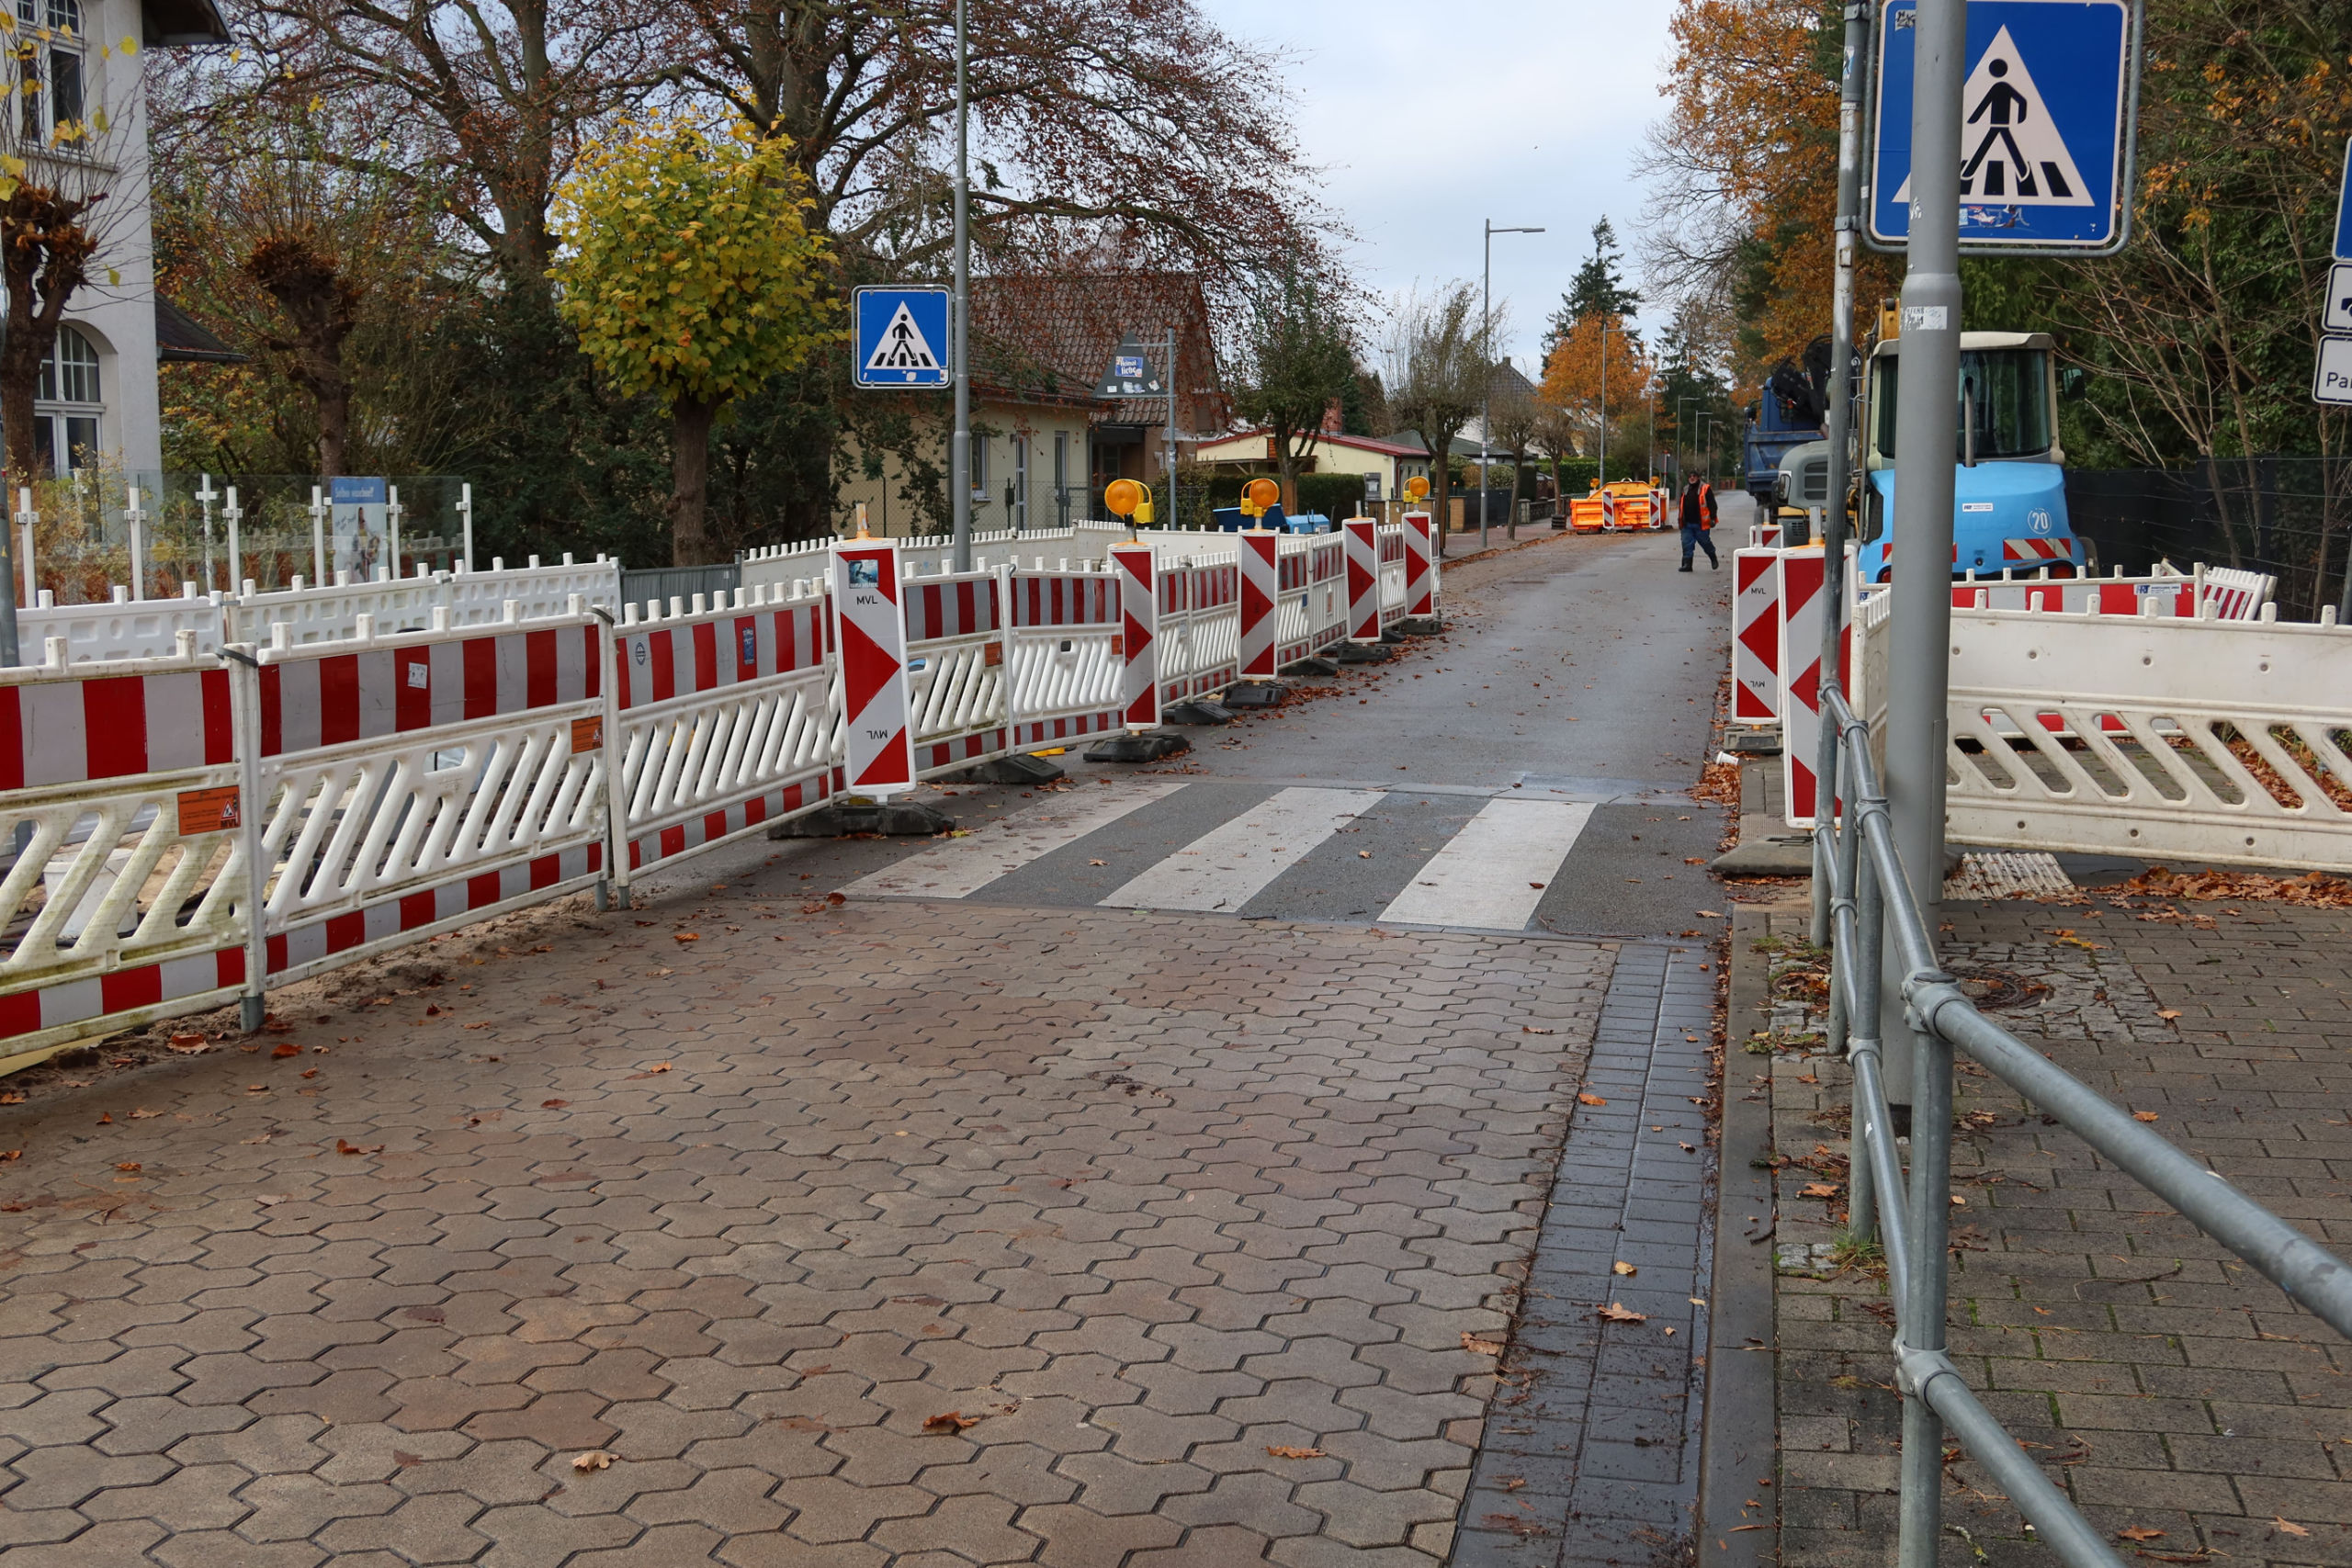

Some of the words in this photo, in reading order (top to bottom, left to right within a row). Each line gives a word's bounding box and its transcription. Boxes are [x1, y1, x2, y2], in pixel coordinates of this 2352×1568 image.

[2032, 512, 2049, 530] 20
[1750, 587, 1766, 595] MVL
[856, 595, 878, 605] MVL
[1749, 680, 1765, 688] MVL
[866, 729, 888, 739] MVL
